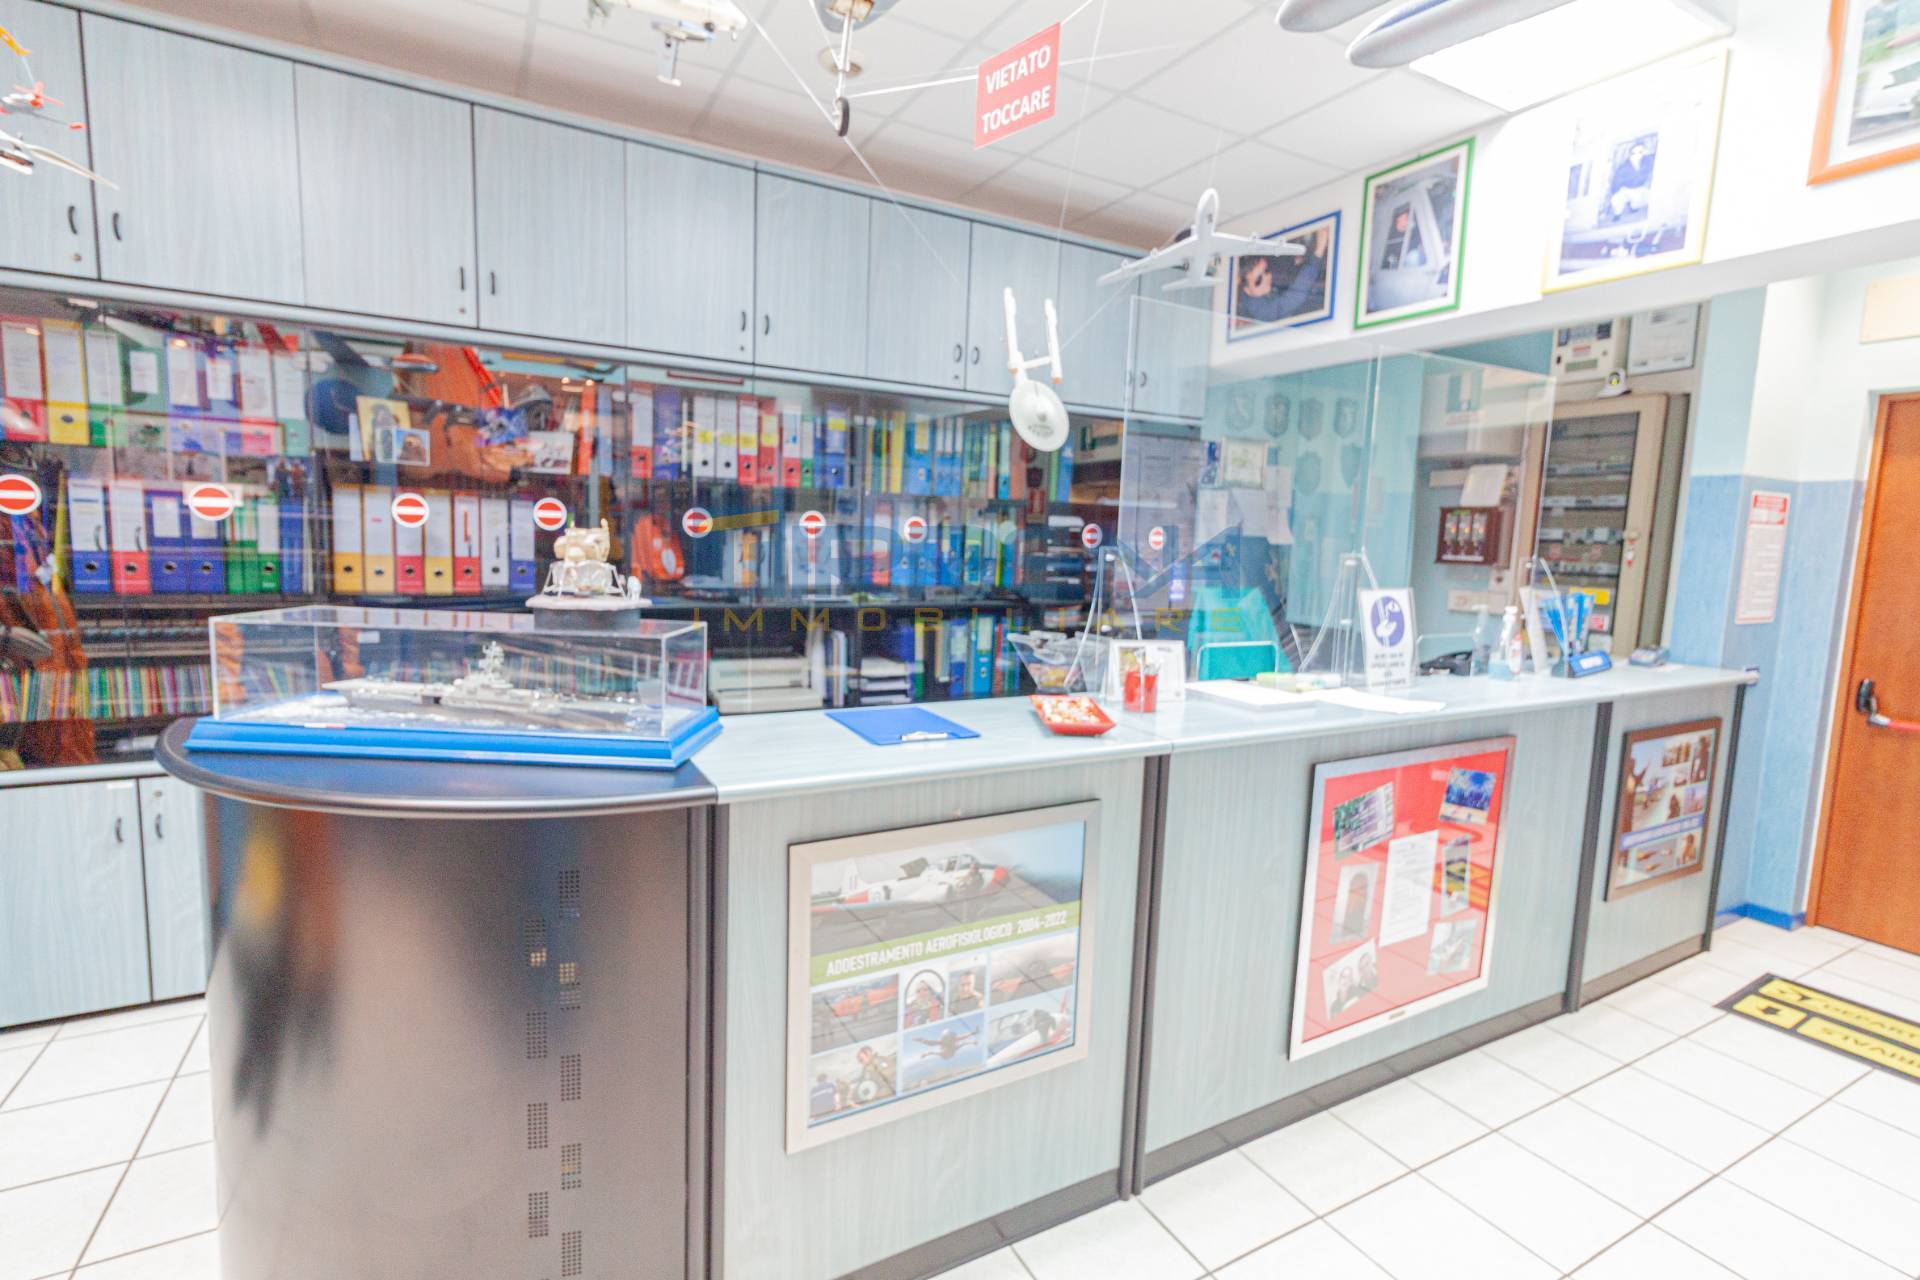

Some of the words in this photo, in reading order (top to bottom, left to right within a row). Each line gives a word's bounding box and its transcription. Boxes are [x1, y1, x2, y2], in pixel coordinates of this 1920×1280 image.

[985, 44, 1051, 95] VIETATO
[981, 84, 1051, 134] TOCCARE
[826, 941, 924, 977] ADDESTRAMENTO
[925, 922, 1013, 954] AEROFISIOLOGICO
